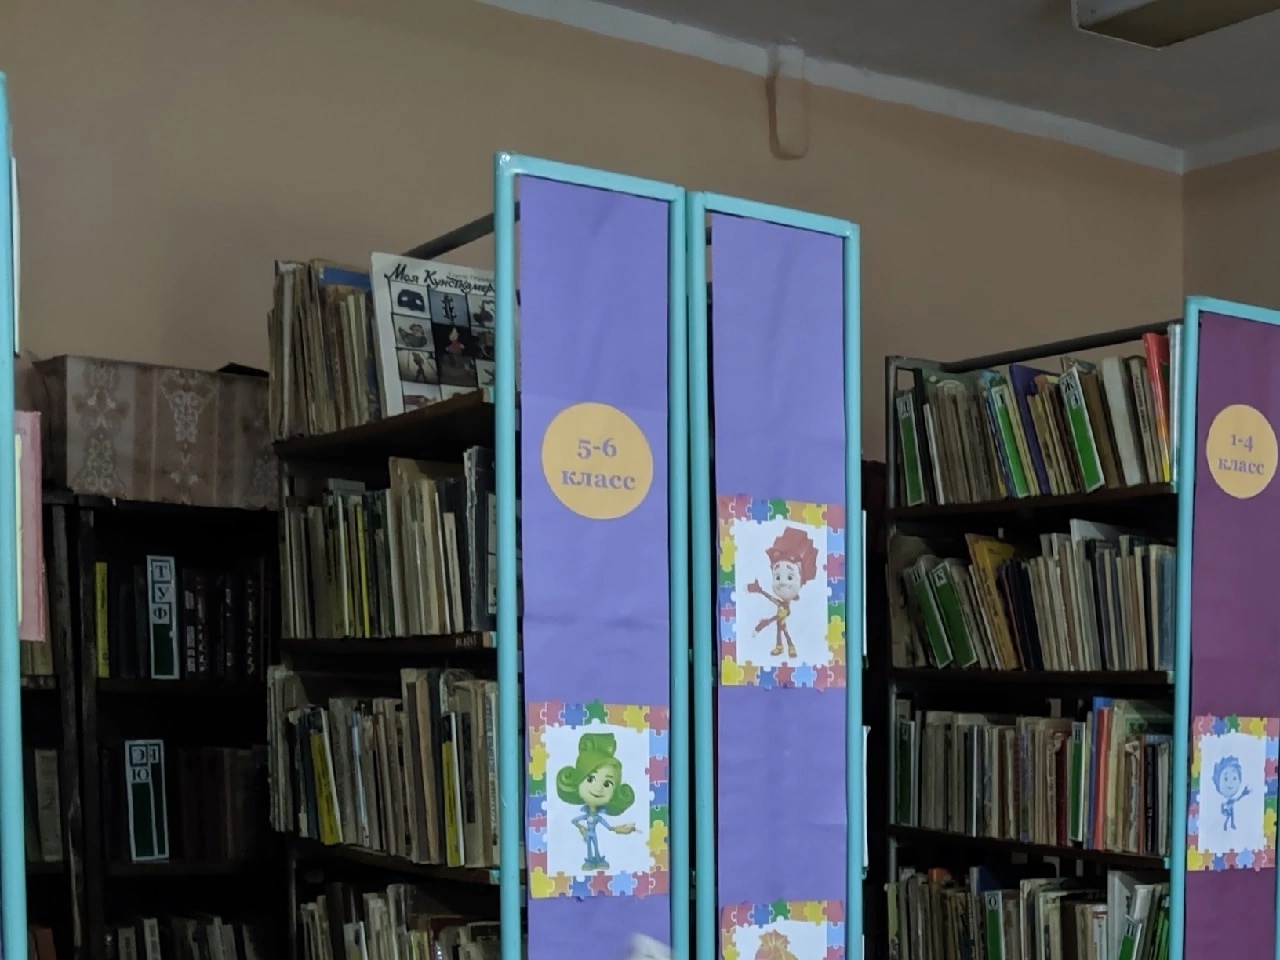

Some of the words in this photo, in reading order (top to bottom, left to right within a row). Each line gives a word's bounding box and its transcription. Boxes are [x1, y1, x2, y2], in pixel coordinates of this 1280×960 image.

[384, 263, 420, 284] Моя
[424, 269, 495, 297] Кунсткамер
[577, 437, 618, 460] 5-6
[1231, 433, 1254, 453] 1-4
[1218, 458, 1265, 476] класс
[561, 470, 636, 490] класс
